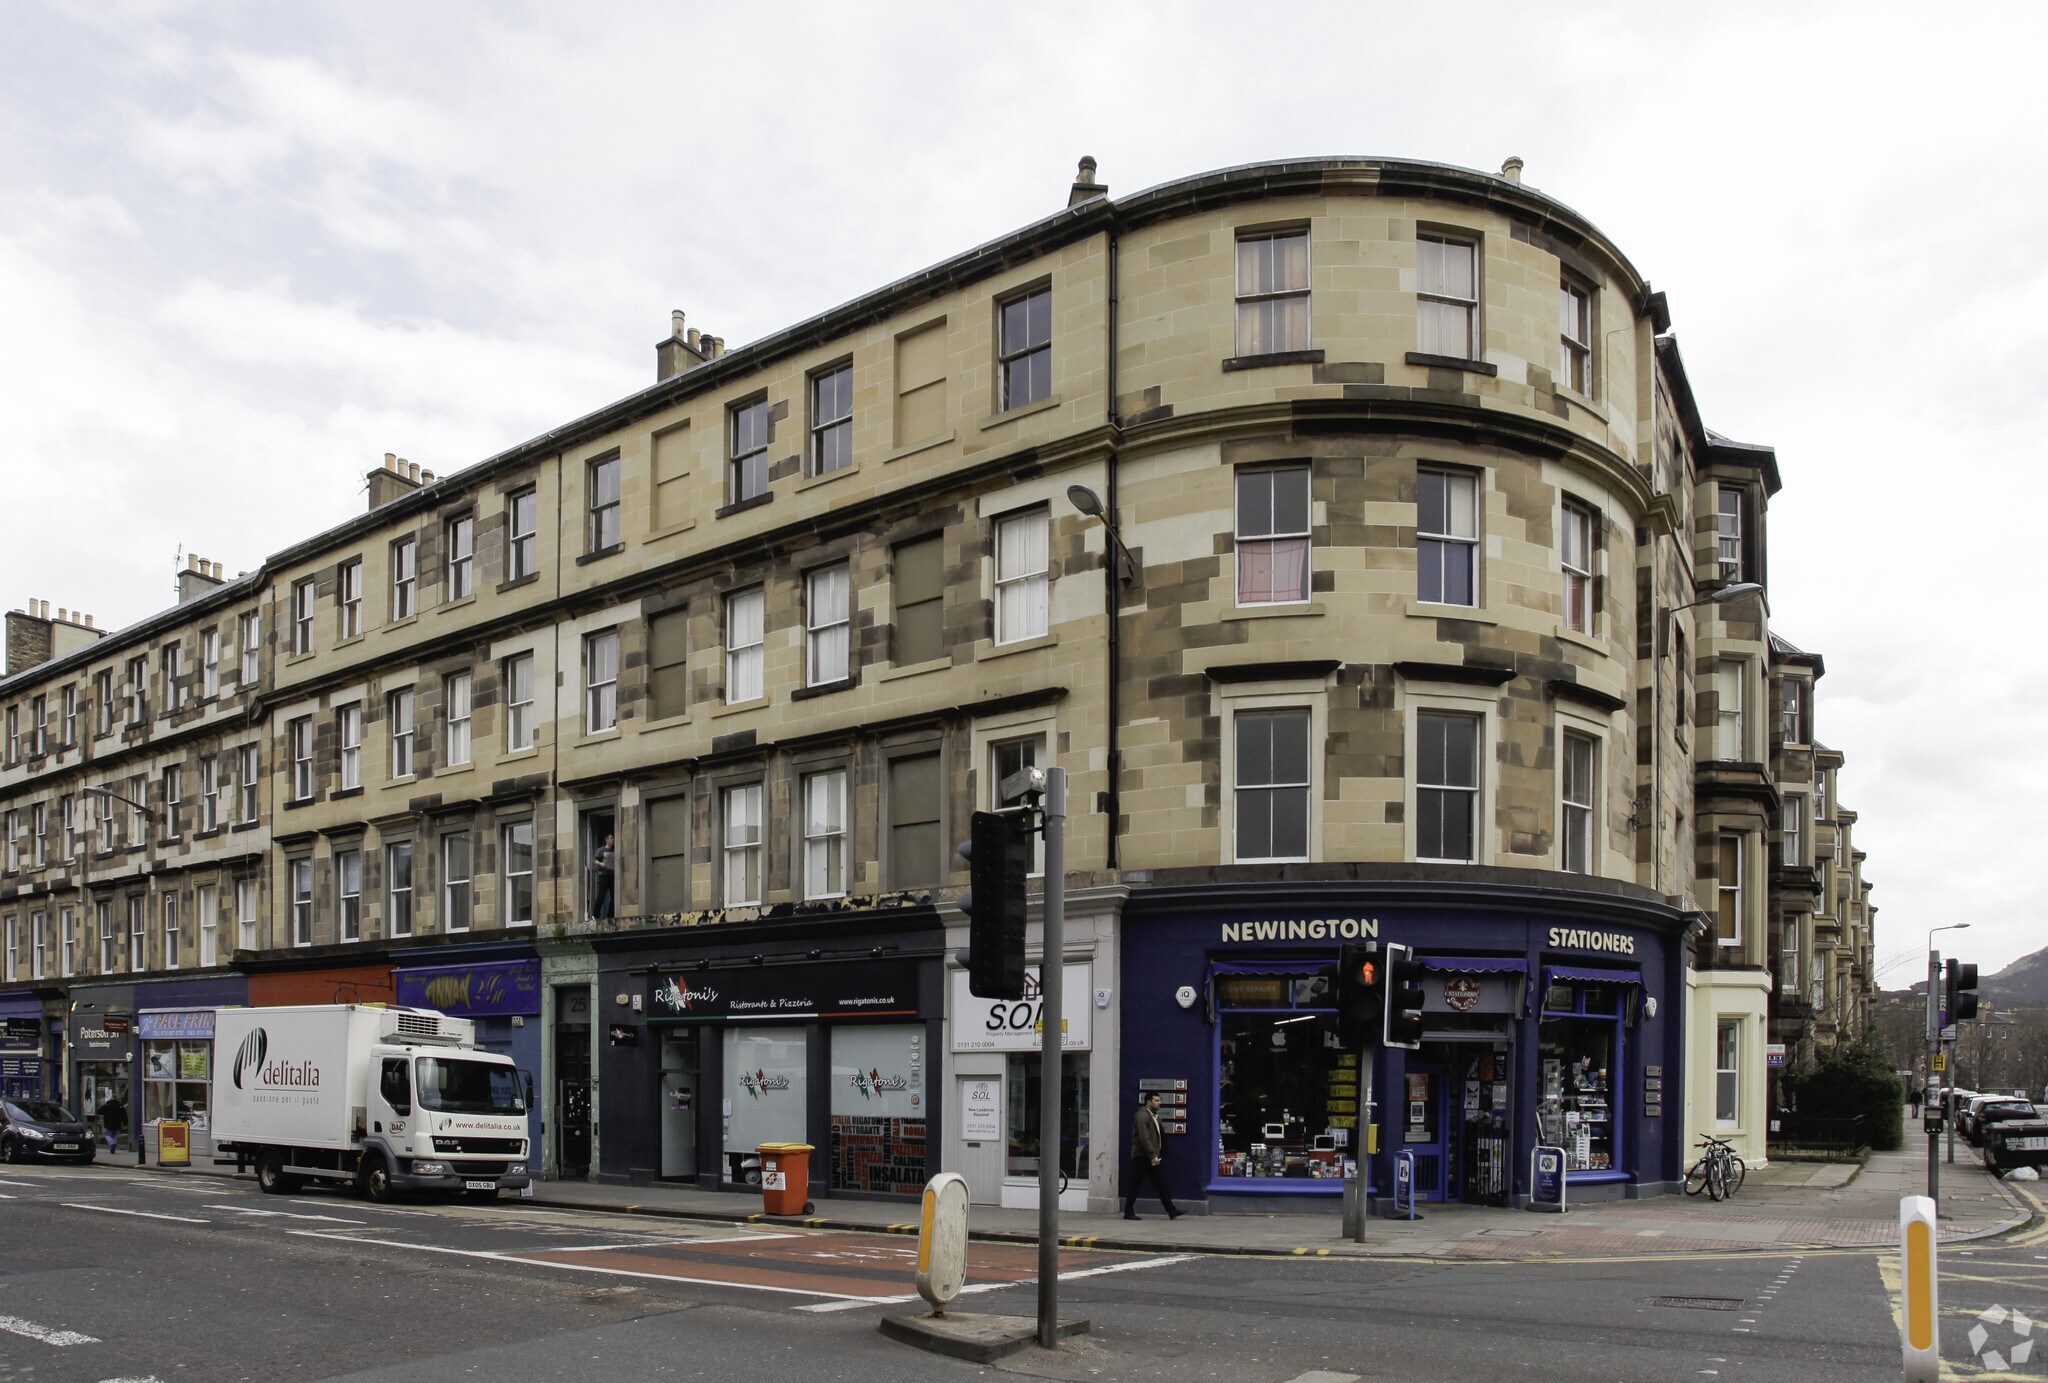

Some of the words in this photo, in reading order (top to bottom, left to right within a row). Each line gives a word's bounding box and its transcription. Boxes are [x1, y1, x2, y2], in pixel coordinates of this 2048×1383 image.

[1222, 919, 1378, 942] NEWINGTON
[1549, 927, 1634, 954] STATIONERS
[655, 986, 718, 1005] Rigatoni's
[839, 996, 895, 1006] www.rigatonis.co.uk
[571, 997, 586, 1012] 25
[730, 1000, 768, 1009] Ristorante
[770, 999, 777, 1008] &
[779, 998, 813, 1007] Pizzeria
[154, 1014, 182, 1029] PACE
[184, 1013, 214, 1029] PRIN
[80, 1027, 109, 1039] Paterson
[1933, 1056, 1944, 1070] H
[263, 1060, 320, 1086] delitalia
[739, 1074, 789, 1088] Rigatoni's
[850, 1075, 907, 1089] Rigatoni's
[303, 1097, 320, 1106] gusto
[391, 1123, 404, 1132] DAC
[455, 1122, 521, 1131] www.delitalia.co.uk
[852, 1117, 884, 1126] RIGATONI
[842, 1126, 881, 1135] RISTORANTE
[904, 1126, 925, 1137] ROMA
[893, 1156, 925, 1167] CALZONE
[869, 1166, 926, 1186] INSALATA
